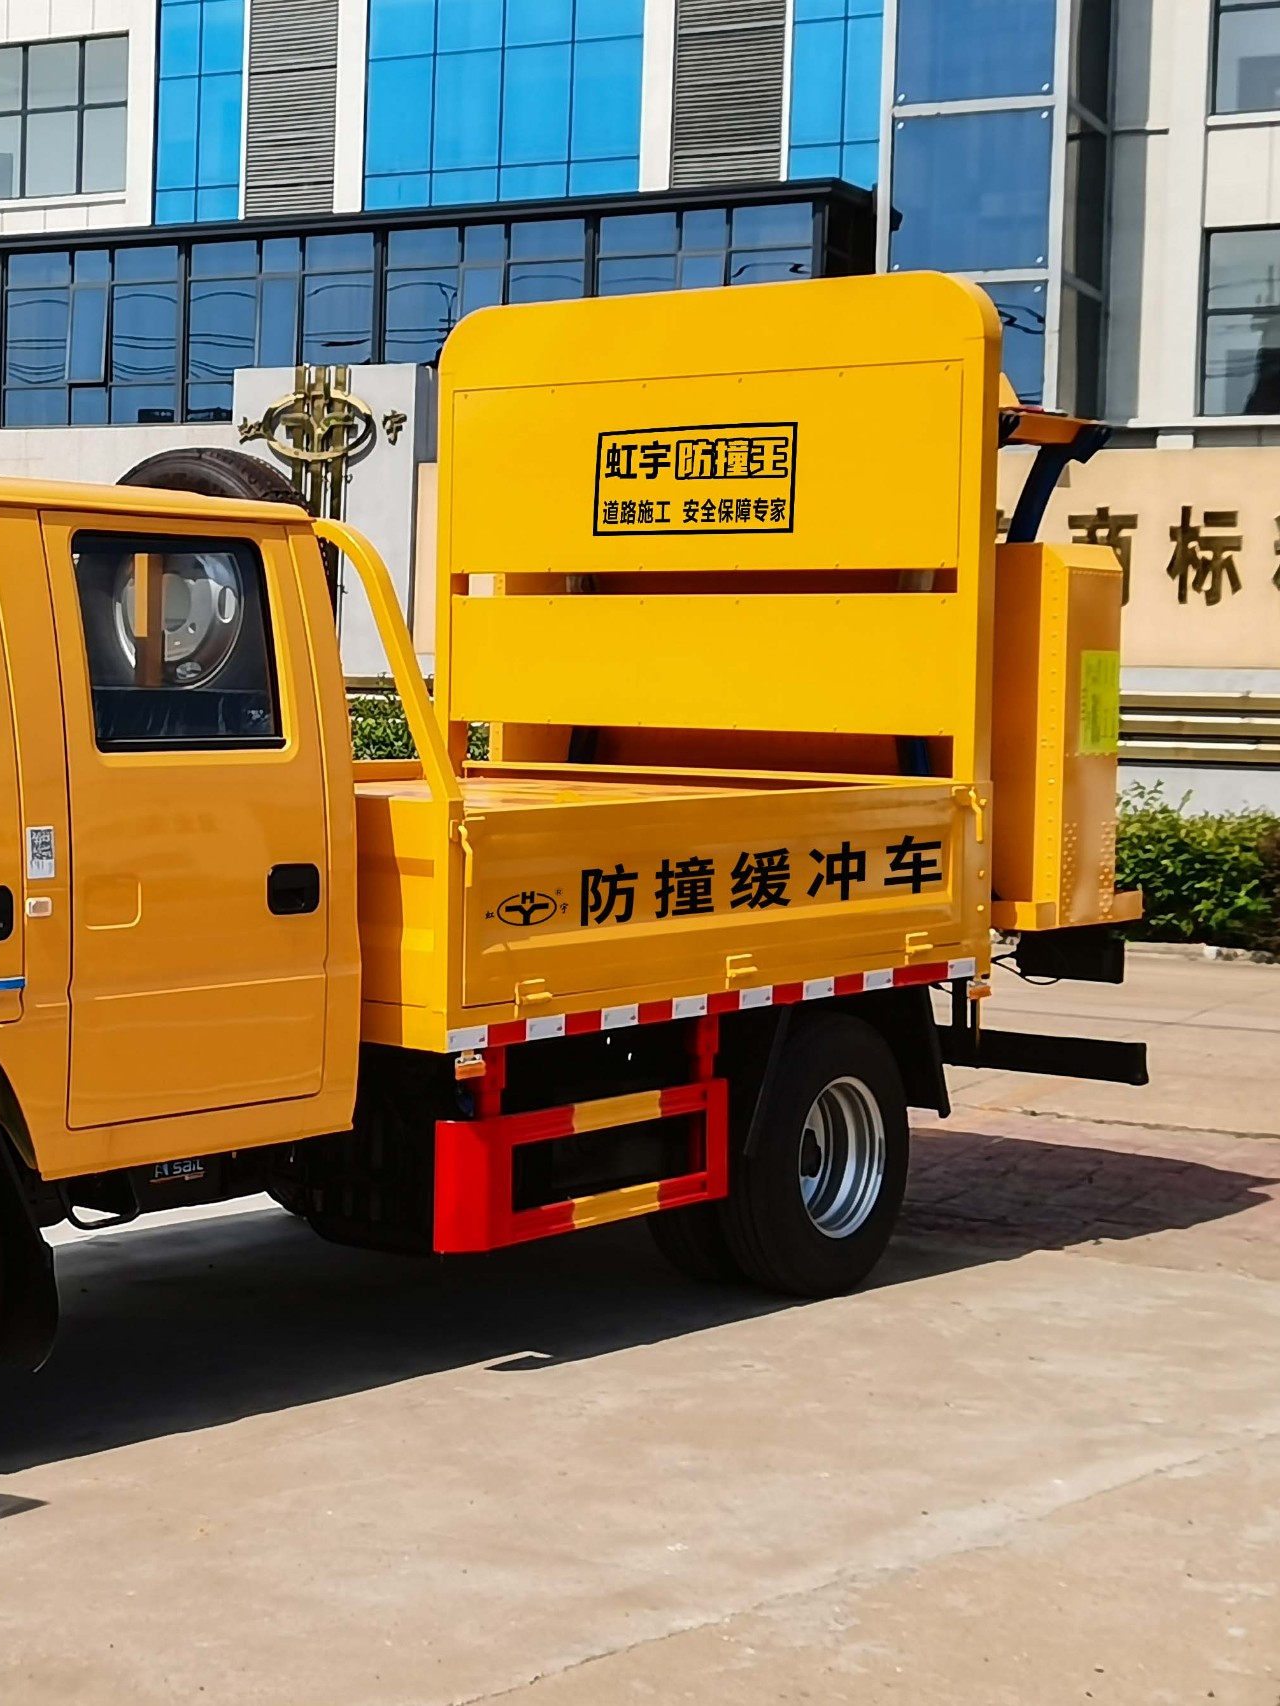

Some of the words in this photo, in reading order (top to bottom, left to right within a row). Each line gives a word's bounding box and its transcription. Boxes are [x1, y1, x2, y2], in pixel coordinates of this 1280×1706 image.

[605, 437, 789, 479] 虹宇防撞王
[603, 499, 671, 525] 道路施工
[683, 498, 787, 524] 安全保障专家
[580, 835, 943, 927] 防撞缓冲车
